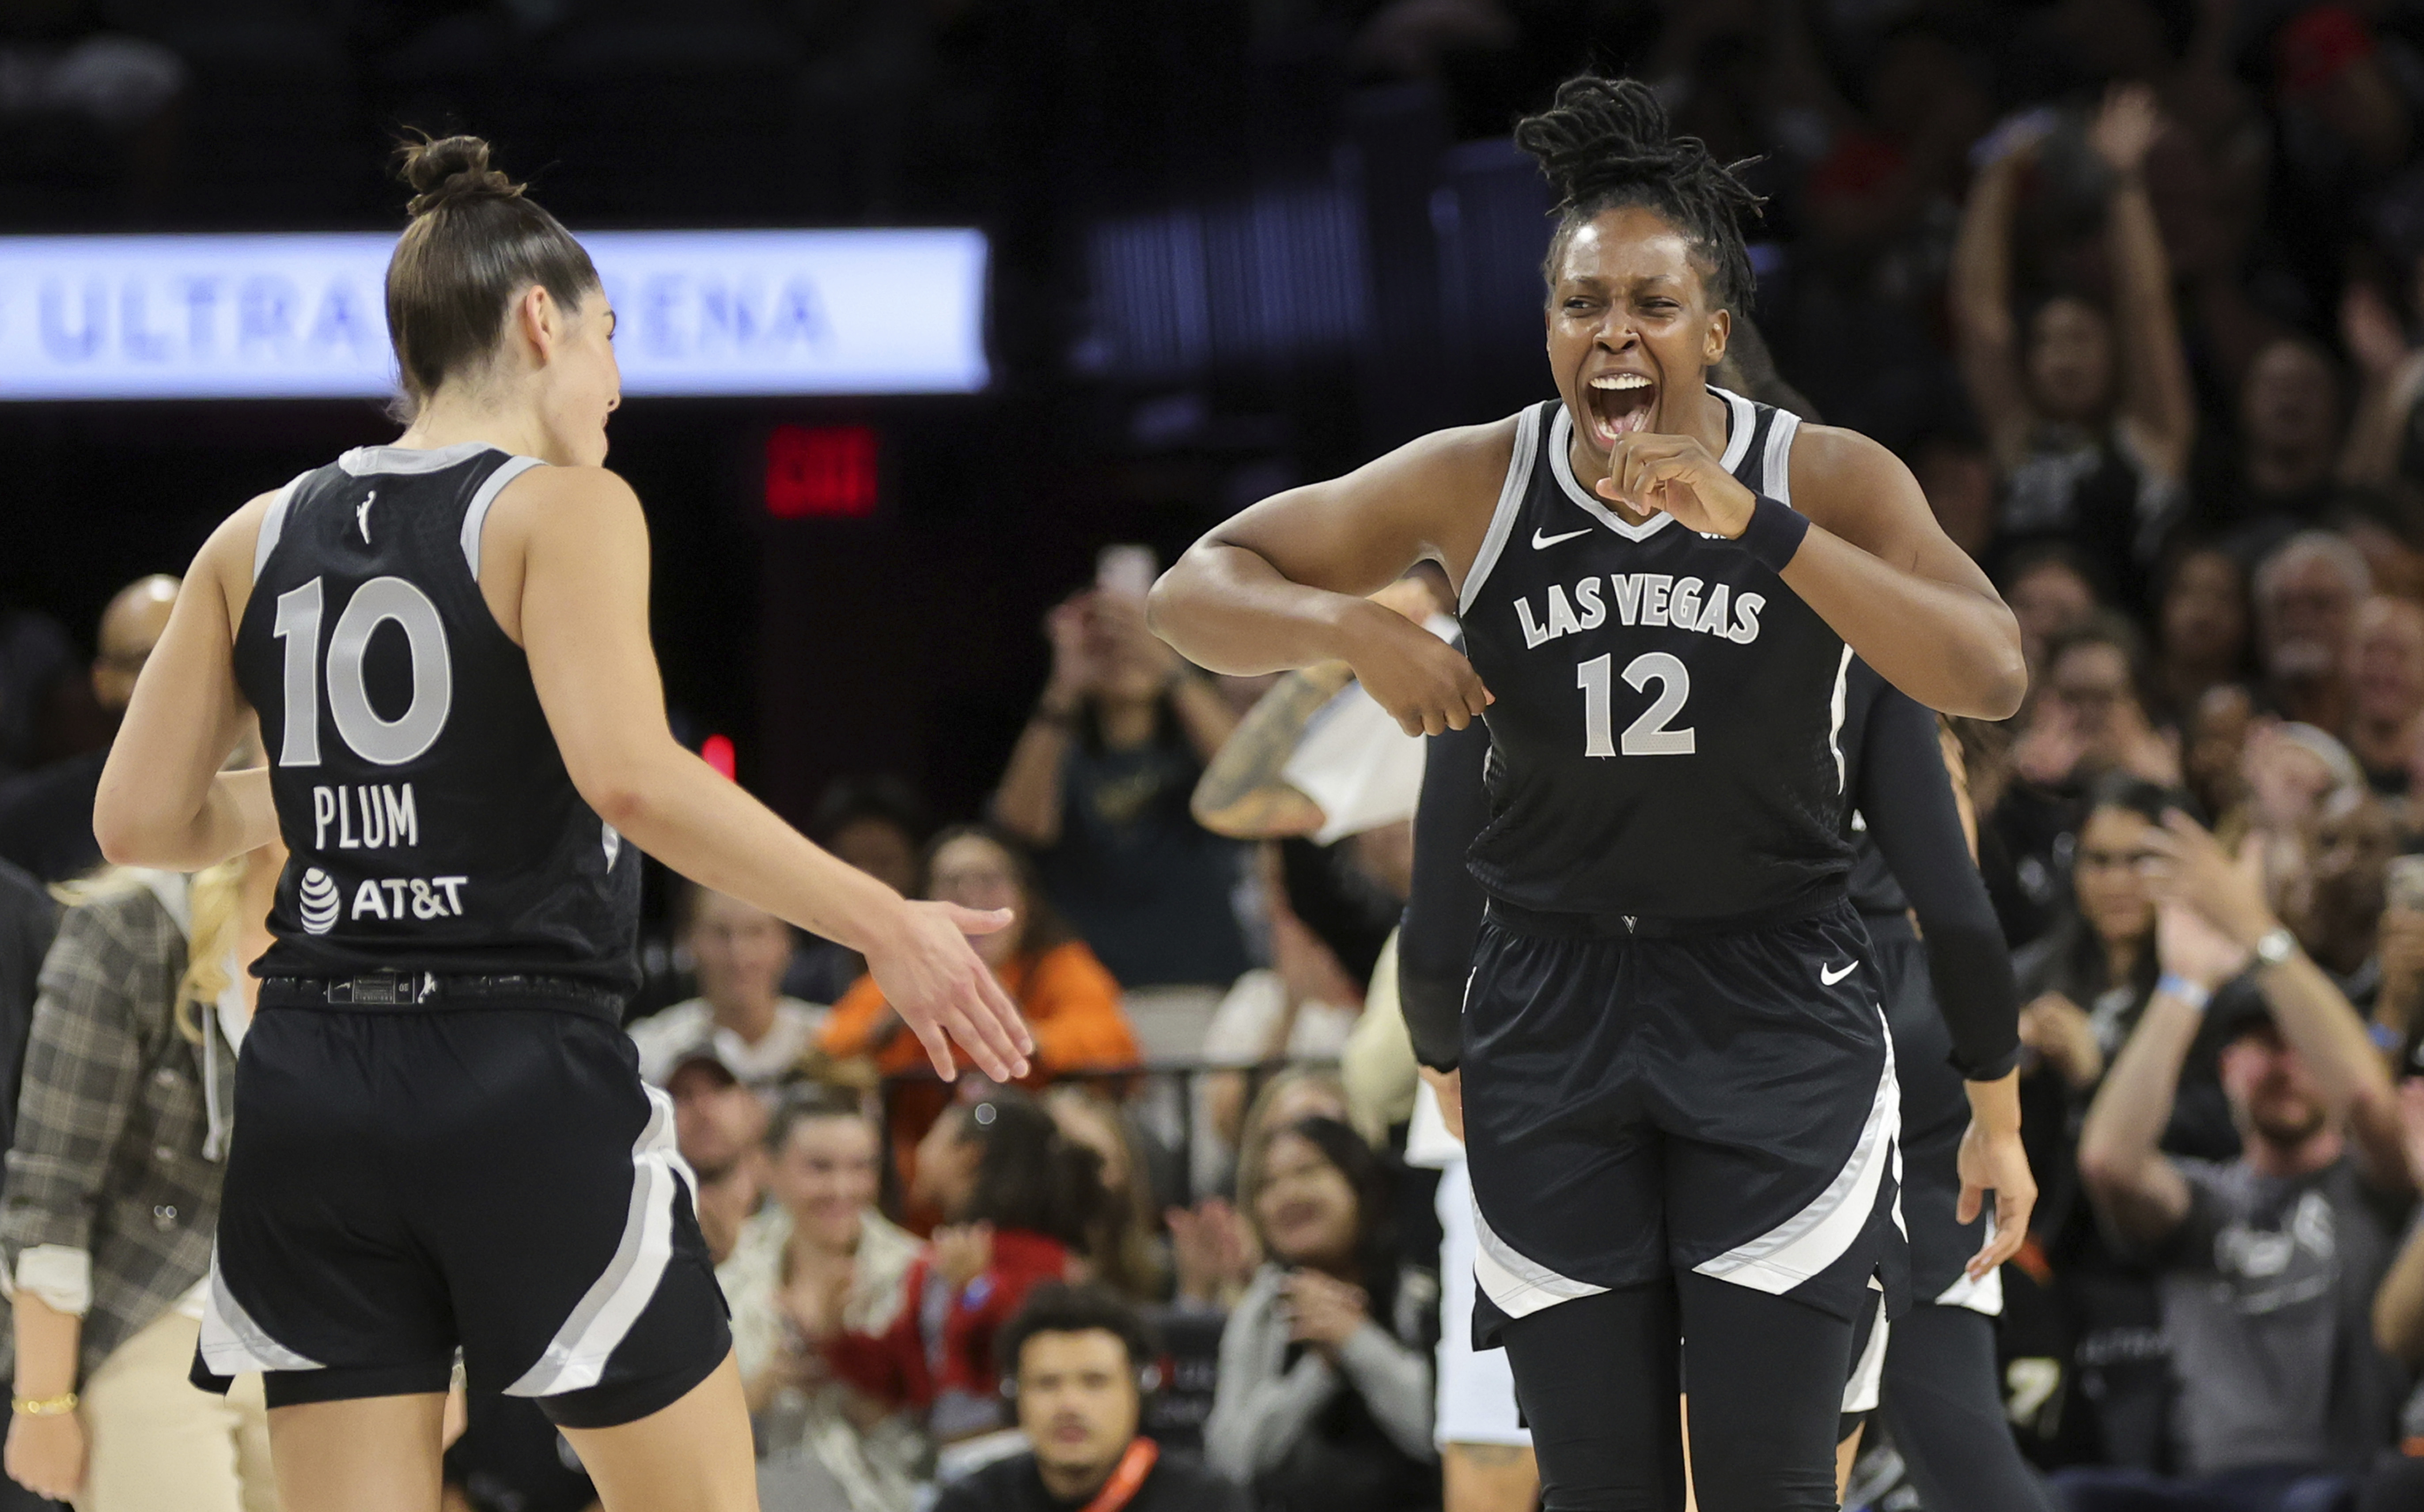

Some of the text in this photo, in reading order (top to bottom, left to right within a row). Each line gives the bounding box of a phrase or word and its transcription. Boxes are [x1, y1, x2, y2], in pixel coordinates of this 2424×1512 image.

[37, 270, 379, 367] ULTRA
[1513, 573, 1766, 650] LAS VEGAS
[273, 575, 453, 767] 10
[1577, 651, 1696, 757] 12
[313, 782, 419, 850] PLUM
[351, 875, 469, 921] AT&T
